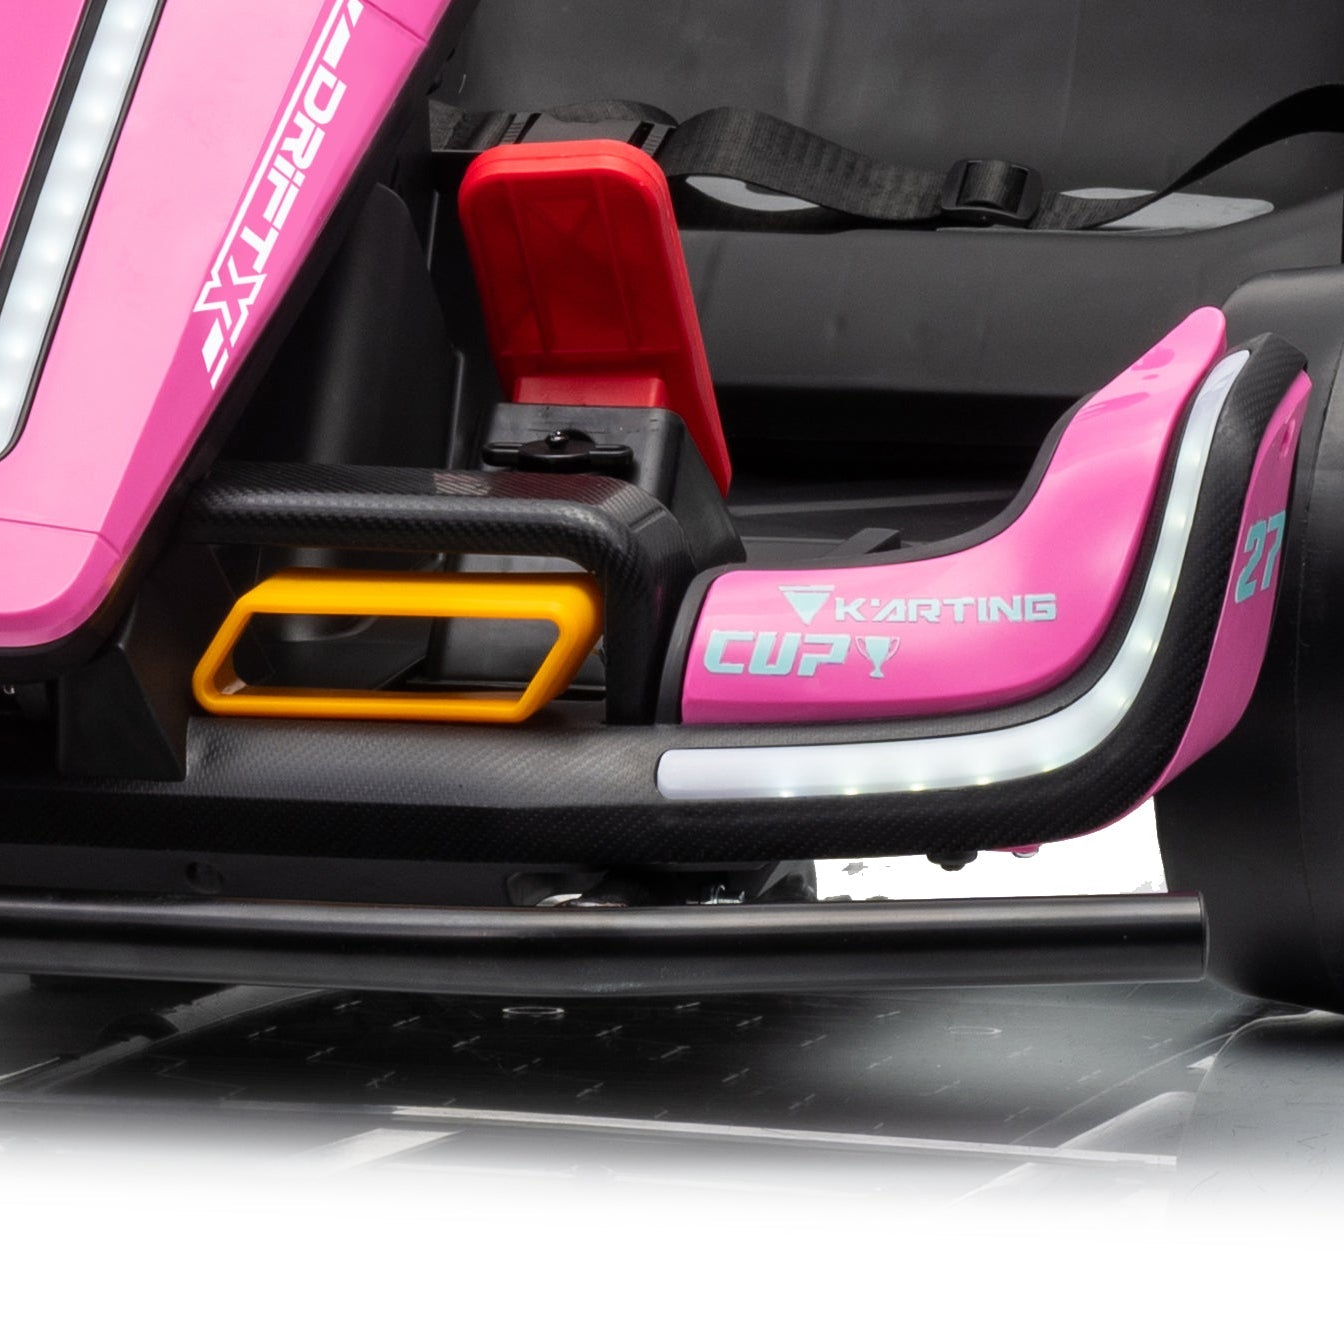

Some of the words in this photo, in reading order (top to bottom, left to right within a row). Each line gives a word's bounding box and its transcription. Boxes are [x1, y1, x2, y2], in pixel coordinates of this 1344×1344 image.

[1233, 510, 1287, 605] 27
[835, 592, 1057, 624] K'ARTING
[702, 630, 854, 677] CUP
